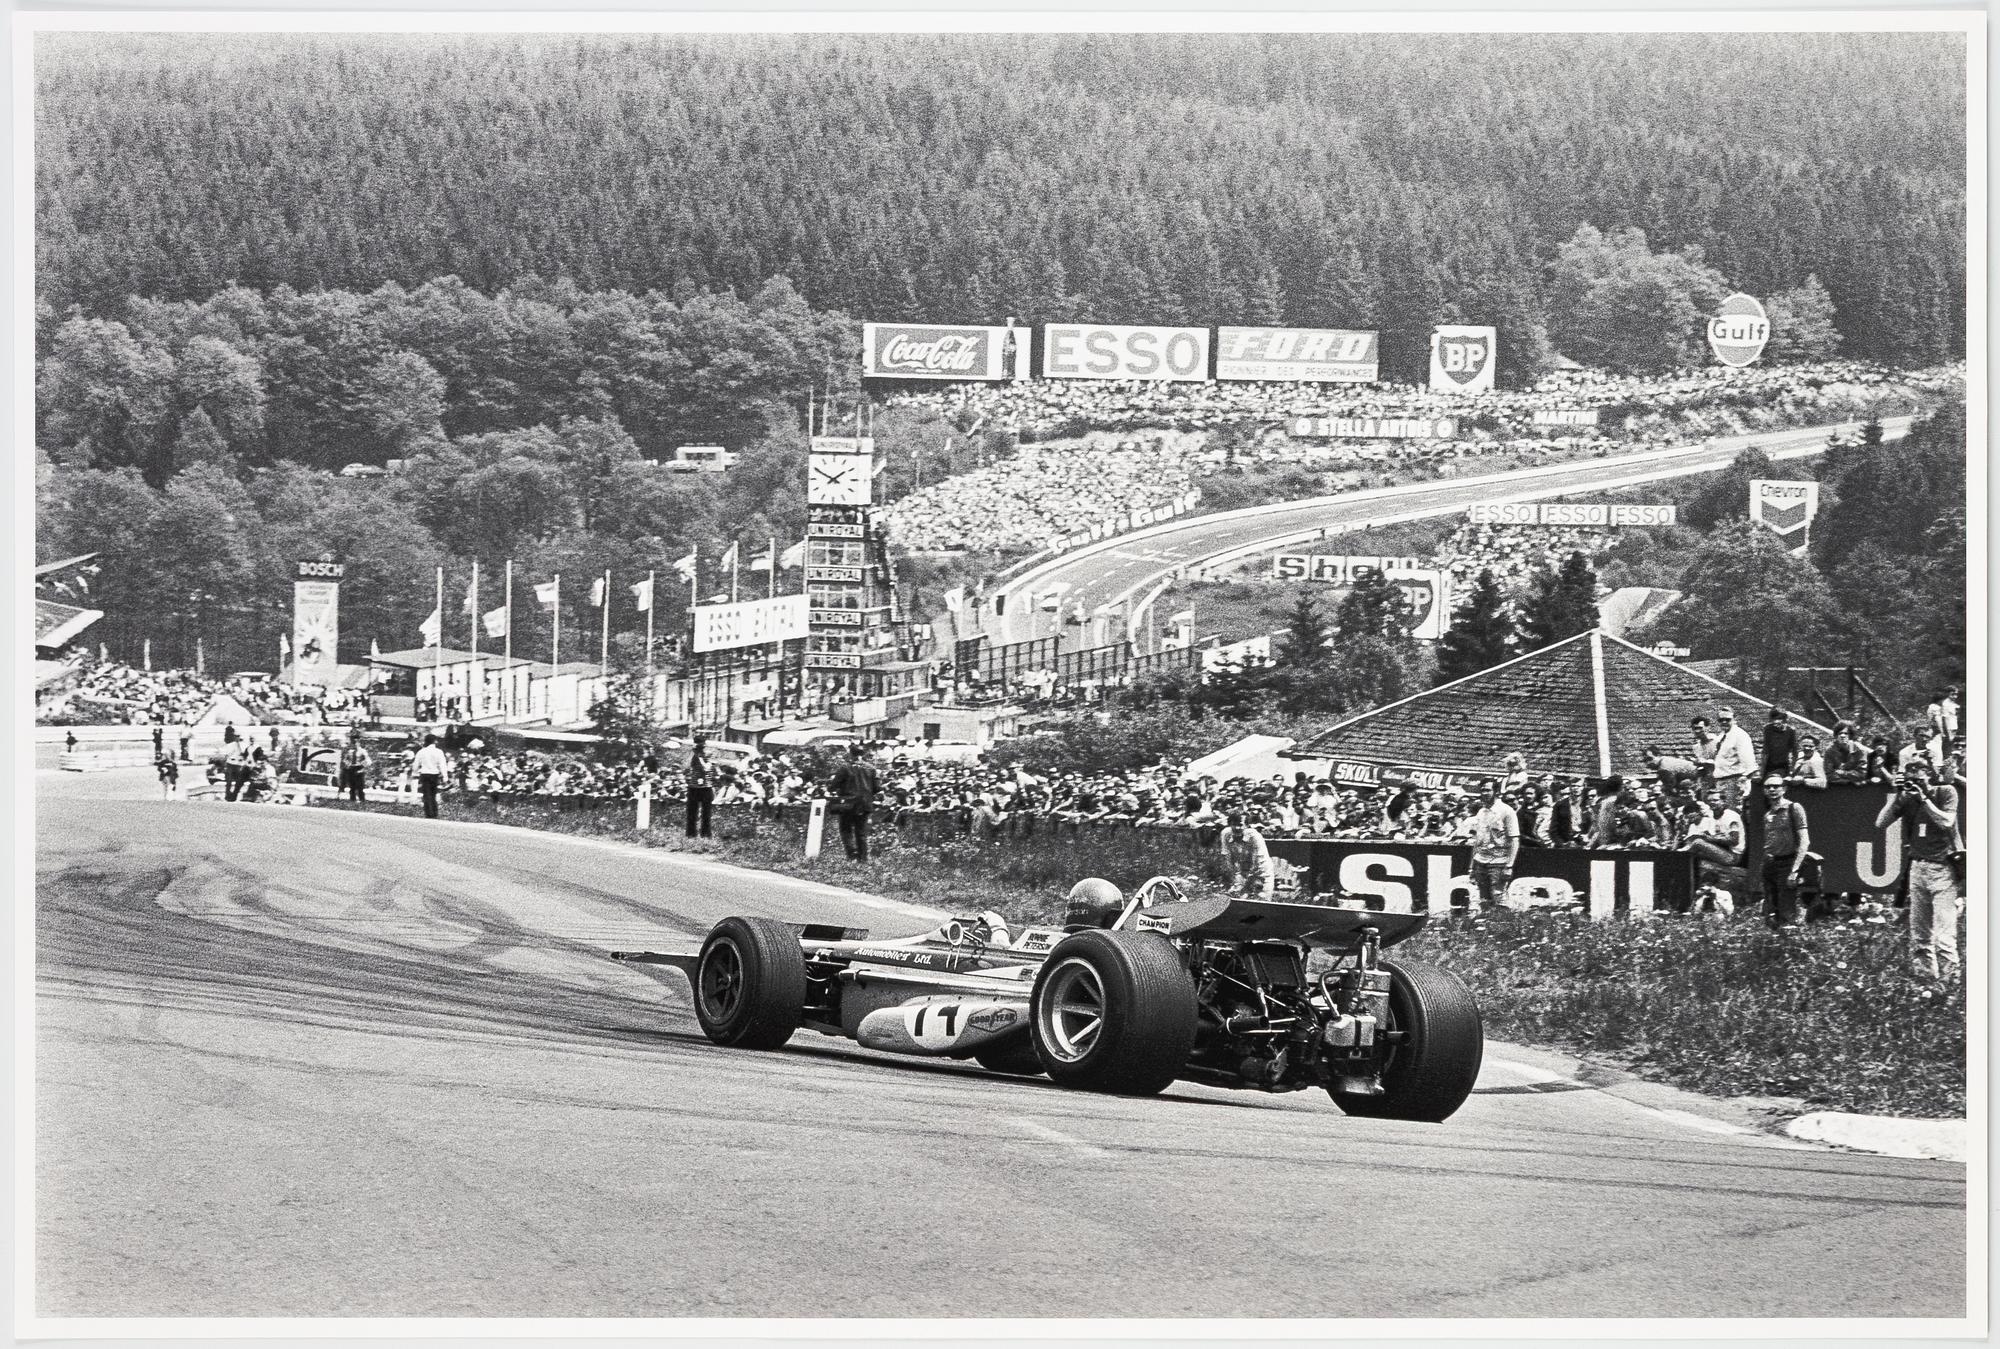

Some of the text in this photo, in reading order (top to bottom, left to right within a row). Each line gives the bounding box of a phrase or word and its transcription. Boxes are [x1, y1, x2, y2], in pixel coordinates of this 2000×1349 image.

[1712, 319, 1766, 340] Gulf
[881, 333, 981, 370] Coca-Cola
[1050, 329, 1201, 376] ESSO
[1229, 330, 1373, 361] FORD
[1444, 343, 1486, 373] BP
[1317, 417, 1376, 437] STELLA
[1474, 505, 1671, 524] ESSO ESSO ESSO
[809, 525, 862, 536] UNIROYAL
[299, 561, 344, 577] BOSCH
[808, 569, 860, 581] UNIROYAL
[809, 613, 860, 624] UNIROYAL
[805, 656, 858, 668] UNIROYAL
[1138, 918, 1170, 930] CHAMPION
[854, 947, 932, 965] Automobiles Ltd.
